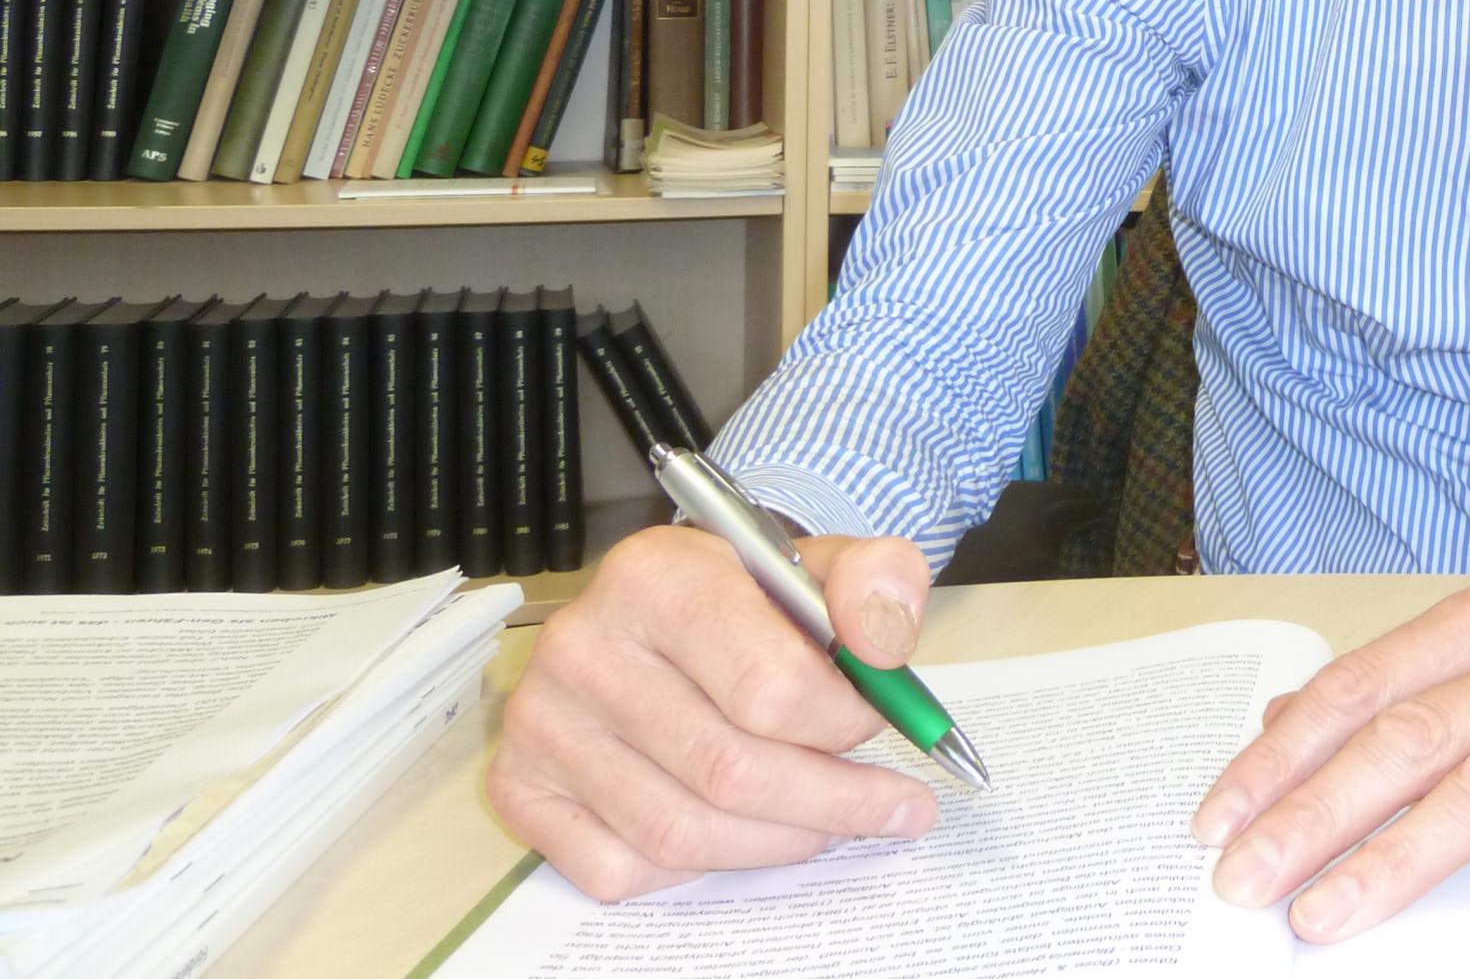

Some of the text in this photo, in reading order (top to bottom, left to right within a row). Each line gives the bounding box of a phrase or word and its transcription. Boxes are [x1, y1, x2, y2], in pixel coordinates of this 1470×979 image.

[34, 5, 47, 62] Pflanzenkrankheiten
[883, 3, 896, 51] ELSTNER:
[111, 7, 125, 64] Pflanzenkrankheiten
[31, 78, 42, 108] Zeitschrift
[107, 78, 118, 109] Zeitschrift
[361, 117, 379, 148] HANS
[372, 66, 398, 115] LÜDECKE
[141, 149, 168, 162] APS
[818, 881, 890, 897] Anfälligkeit
[961, 873, 1070, 898] Beobachtungen
[1052, 877, 1120, 894] Allerdings
[976, 894, 1067, 916] vorliegenden
[982, 892, 1022, 905] durch
[1114, 898, 1194, 907] induzierten
[662, 905, 752, 918] Pathosystem
[901, 902, 948, 917] obligat
[1030, 900, 1108, 918] Anfälligkeit
[1122, 909, 1190, 917] virulenter
[644, 916, 744, 929] hemibiotrophe
[830, 910, 895, 926] biotrophe
[870, 918, 918, 932] Effekte
[926, 911, 968, 924] Arbeit
[957, 911, 1024, 930] abhängig
[1128, 920, 1188, 928] Autoren
[730, 920, 822, 936] Lebensweise
[1004, 920, 1048, 933] immer
[1050, 923, 1120, 938] vermuten
[656, 938, 736, 950] Anfälligkeit
[742, 931, 820, 946] induzierten
[890, 934, 952, 950] relativen
[1057, 933, 1138, 948] avirulenten
[650, 948, 746, 962] phänotypisch
[750, 942, 822, 956] Resistenz
[1004, 943, 1051, 956] Isolats
[610, 965, 683, 974] Resistenz
[694, 958, 774, 971] induzierten
